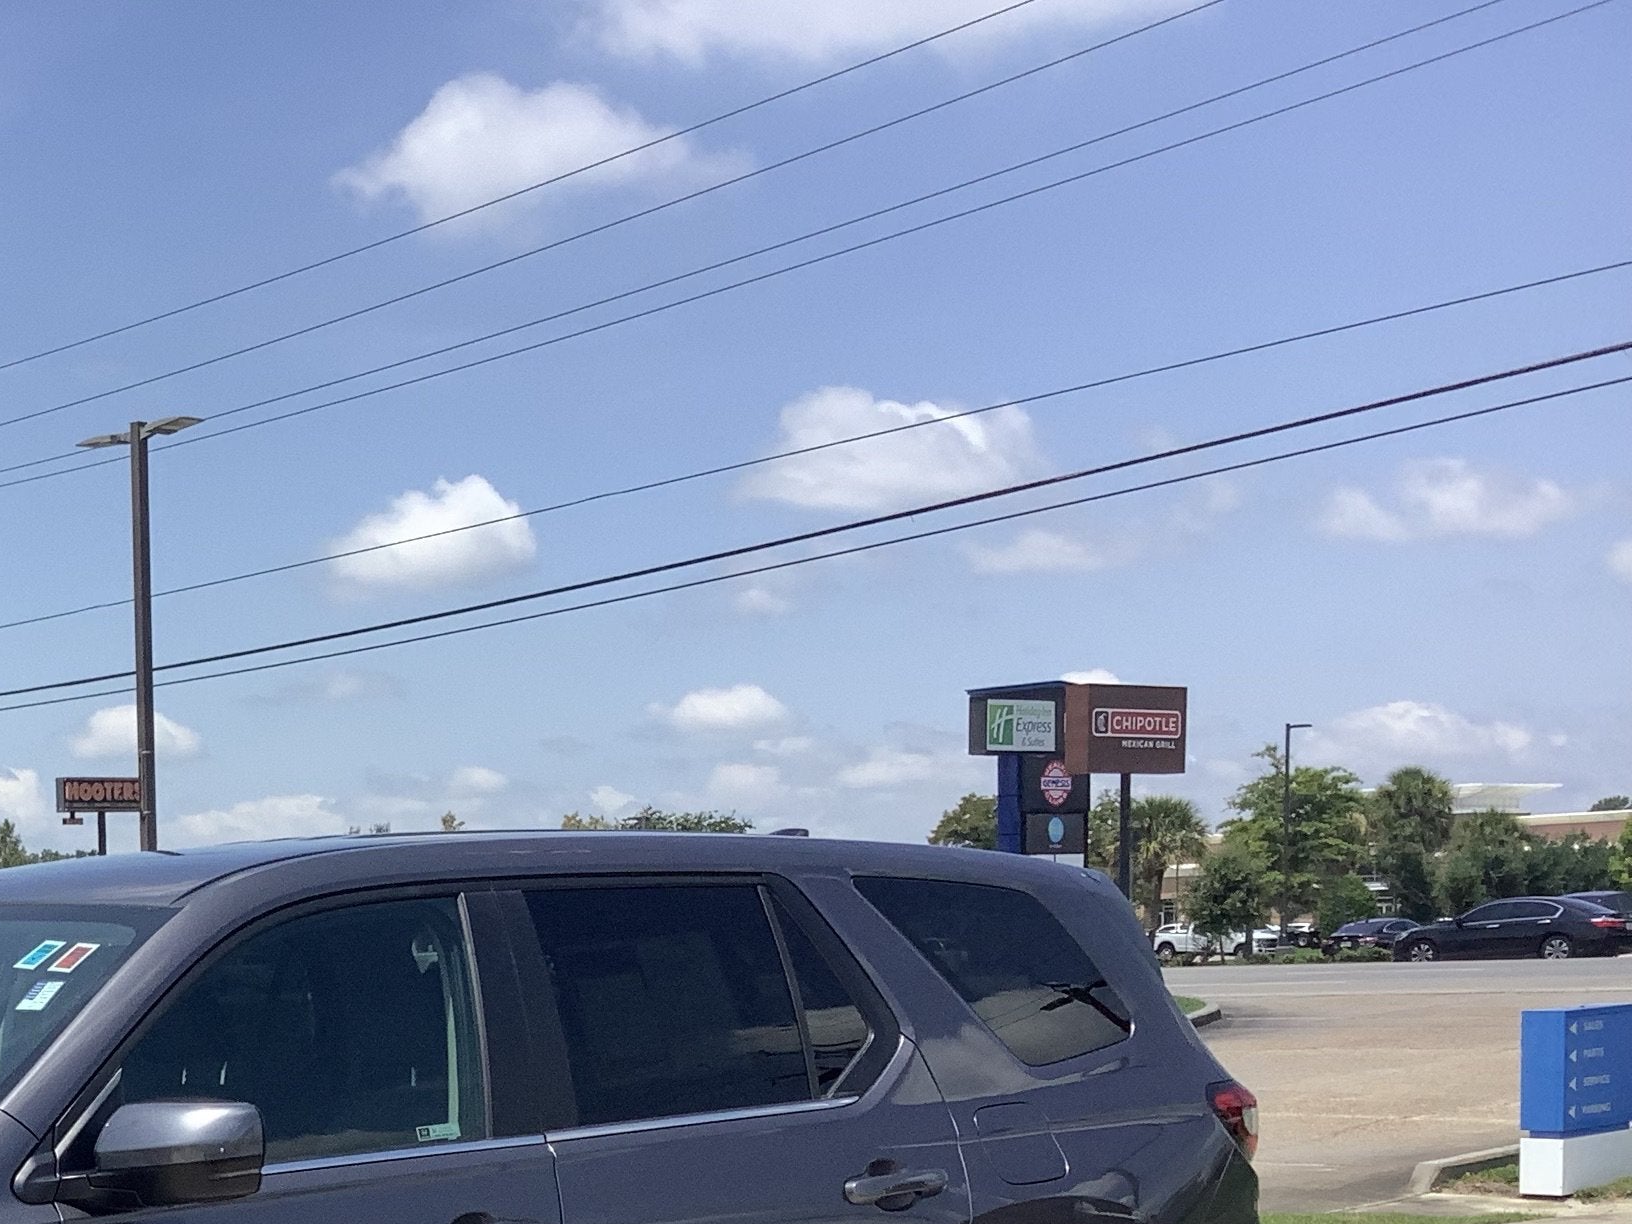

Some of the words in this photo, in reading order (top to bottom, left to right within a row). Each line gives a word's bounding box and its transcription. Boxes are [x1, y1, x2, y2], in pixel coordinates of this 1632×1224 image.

[1016, 717, 1052, 736] Express
[1112, 715, 1177, 732] CHIPOTLE
[1121, 739, 1154, 749] MEXICAN
[1155, 740, 1176, 750] GRILL
